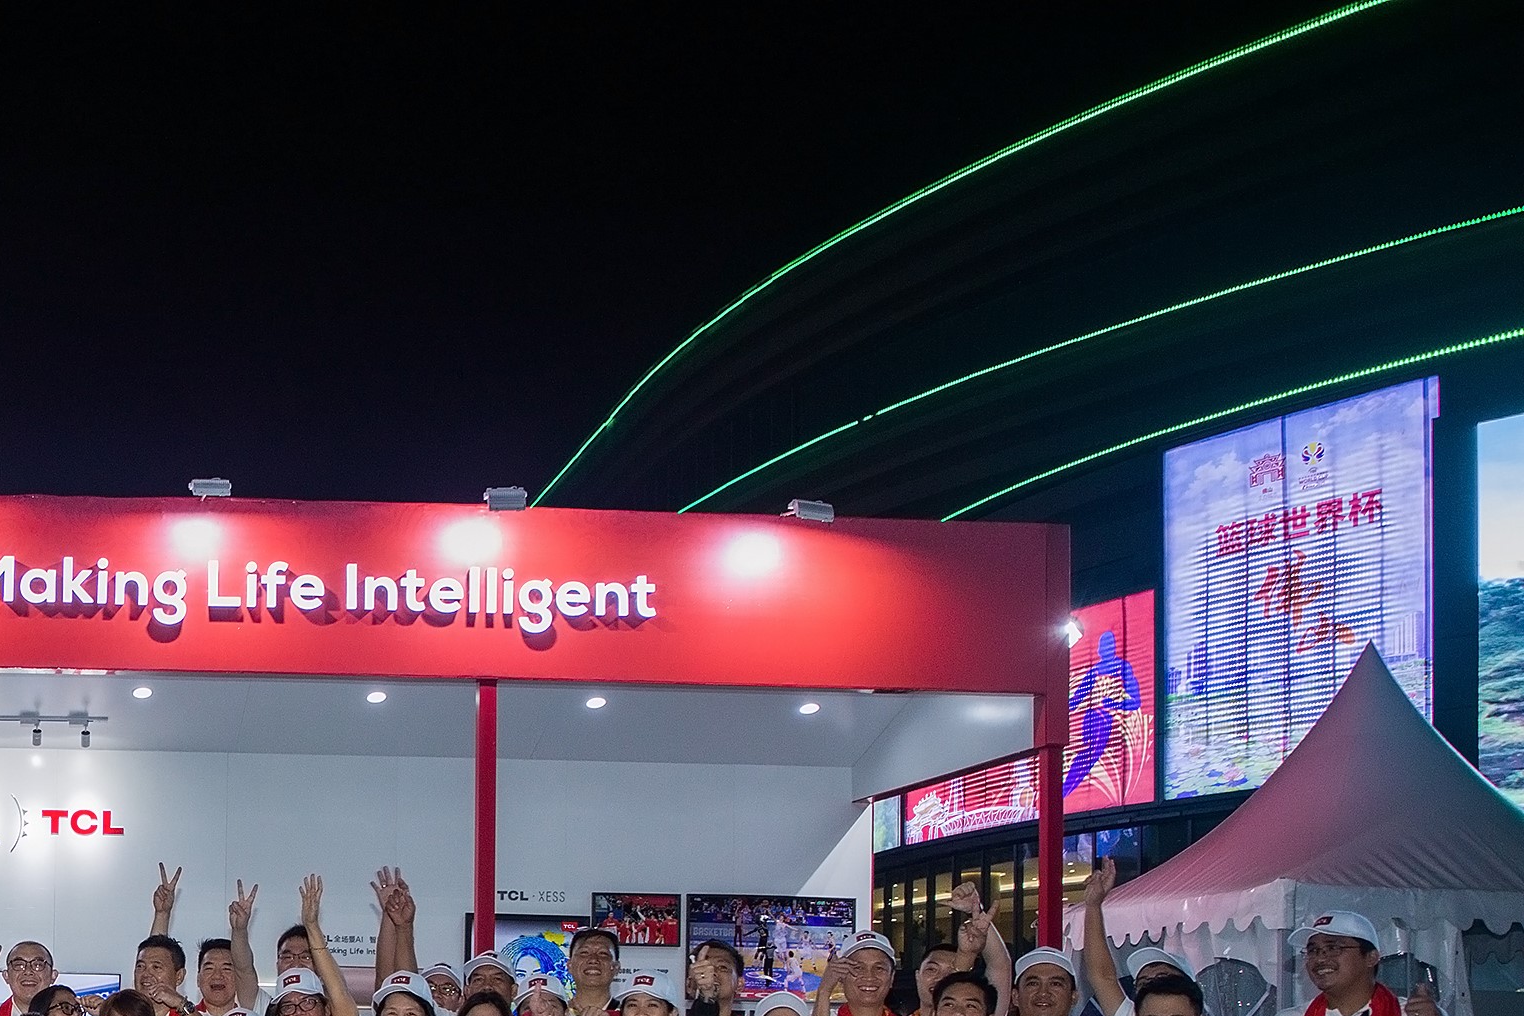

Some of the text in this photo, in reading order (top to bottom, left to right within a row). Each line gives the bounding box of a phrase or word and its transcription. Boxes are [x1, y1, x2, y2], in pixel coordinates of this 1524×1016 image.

[1214, 487, 1383, 558] 篮球世界杯
[206, 559, 326, 611] Life
[346, 563, 657, 634] Intelligent
[42, 810, 124, 835] TCL
[497, 890, 566, 902] TCL XESS
[328, 947, 348, 957] aking
